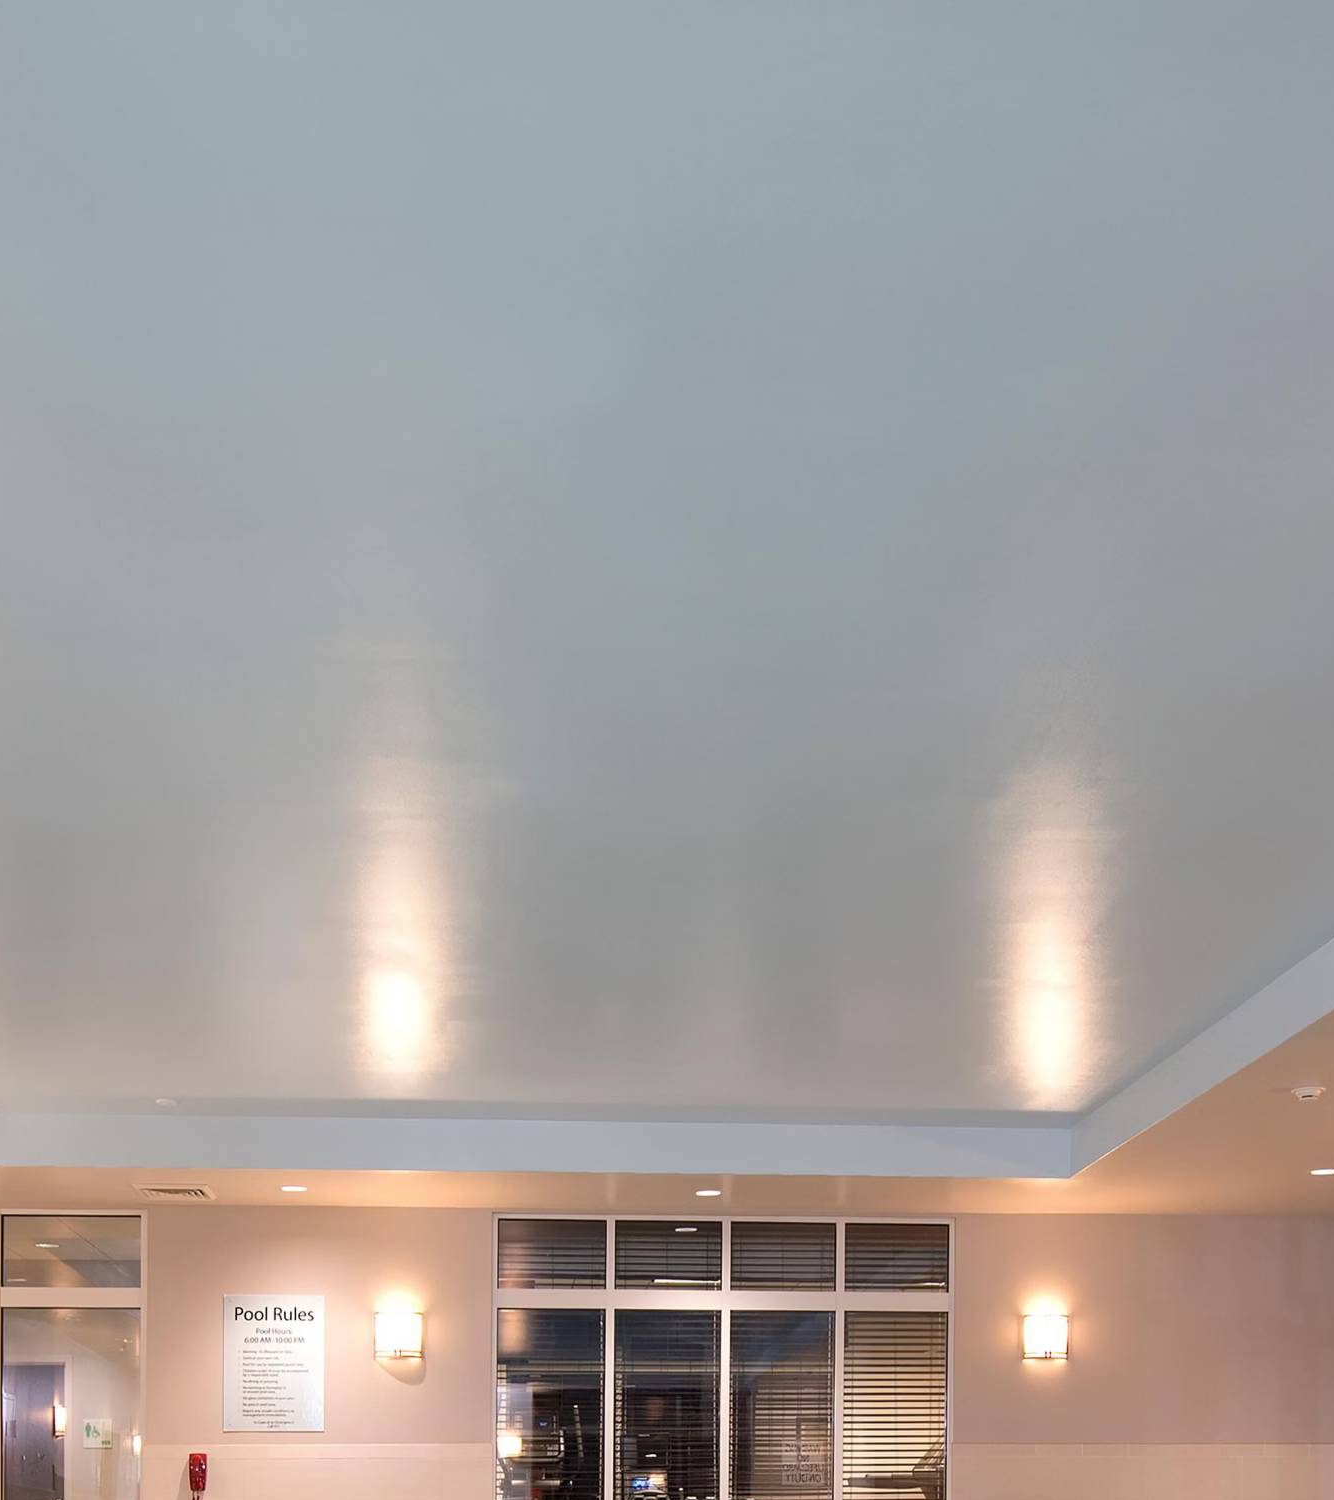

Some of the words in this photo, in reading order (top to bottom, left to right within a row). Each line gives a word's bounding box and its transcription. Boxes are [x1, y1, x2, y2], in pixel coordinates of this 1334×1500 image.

[235, 1306, 268, 1321] Pool
[273, 1306, 315, 1321] Rules
[255, 1327, 271, 1335] Pool
[260, 1336, 272, 1344] AM
